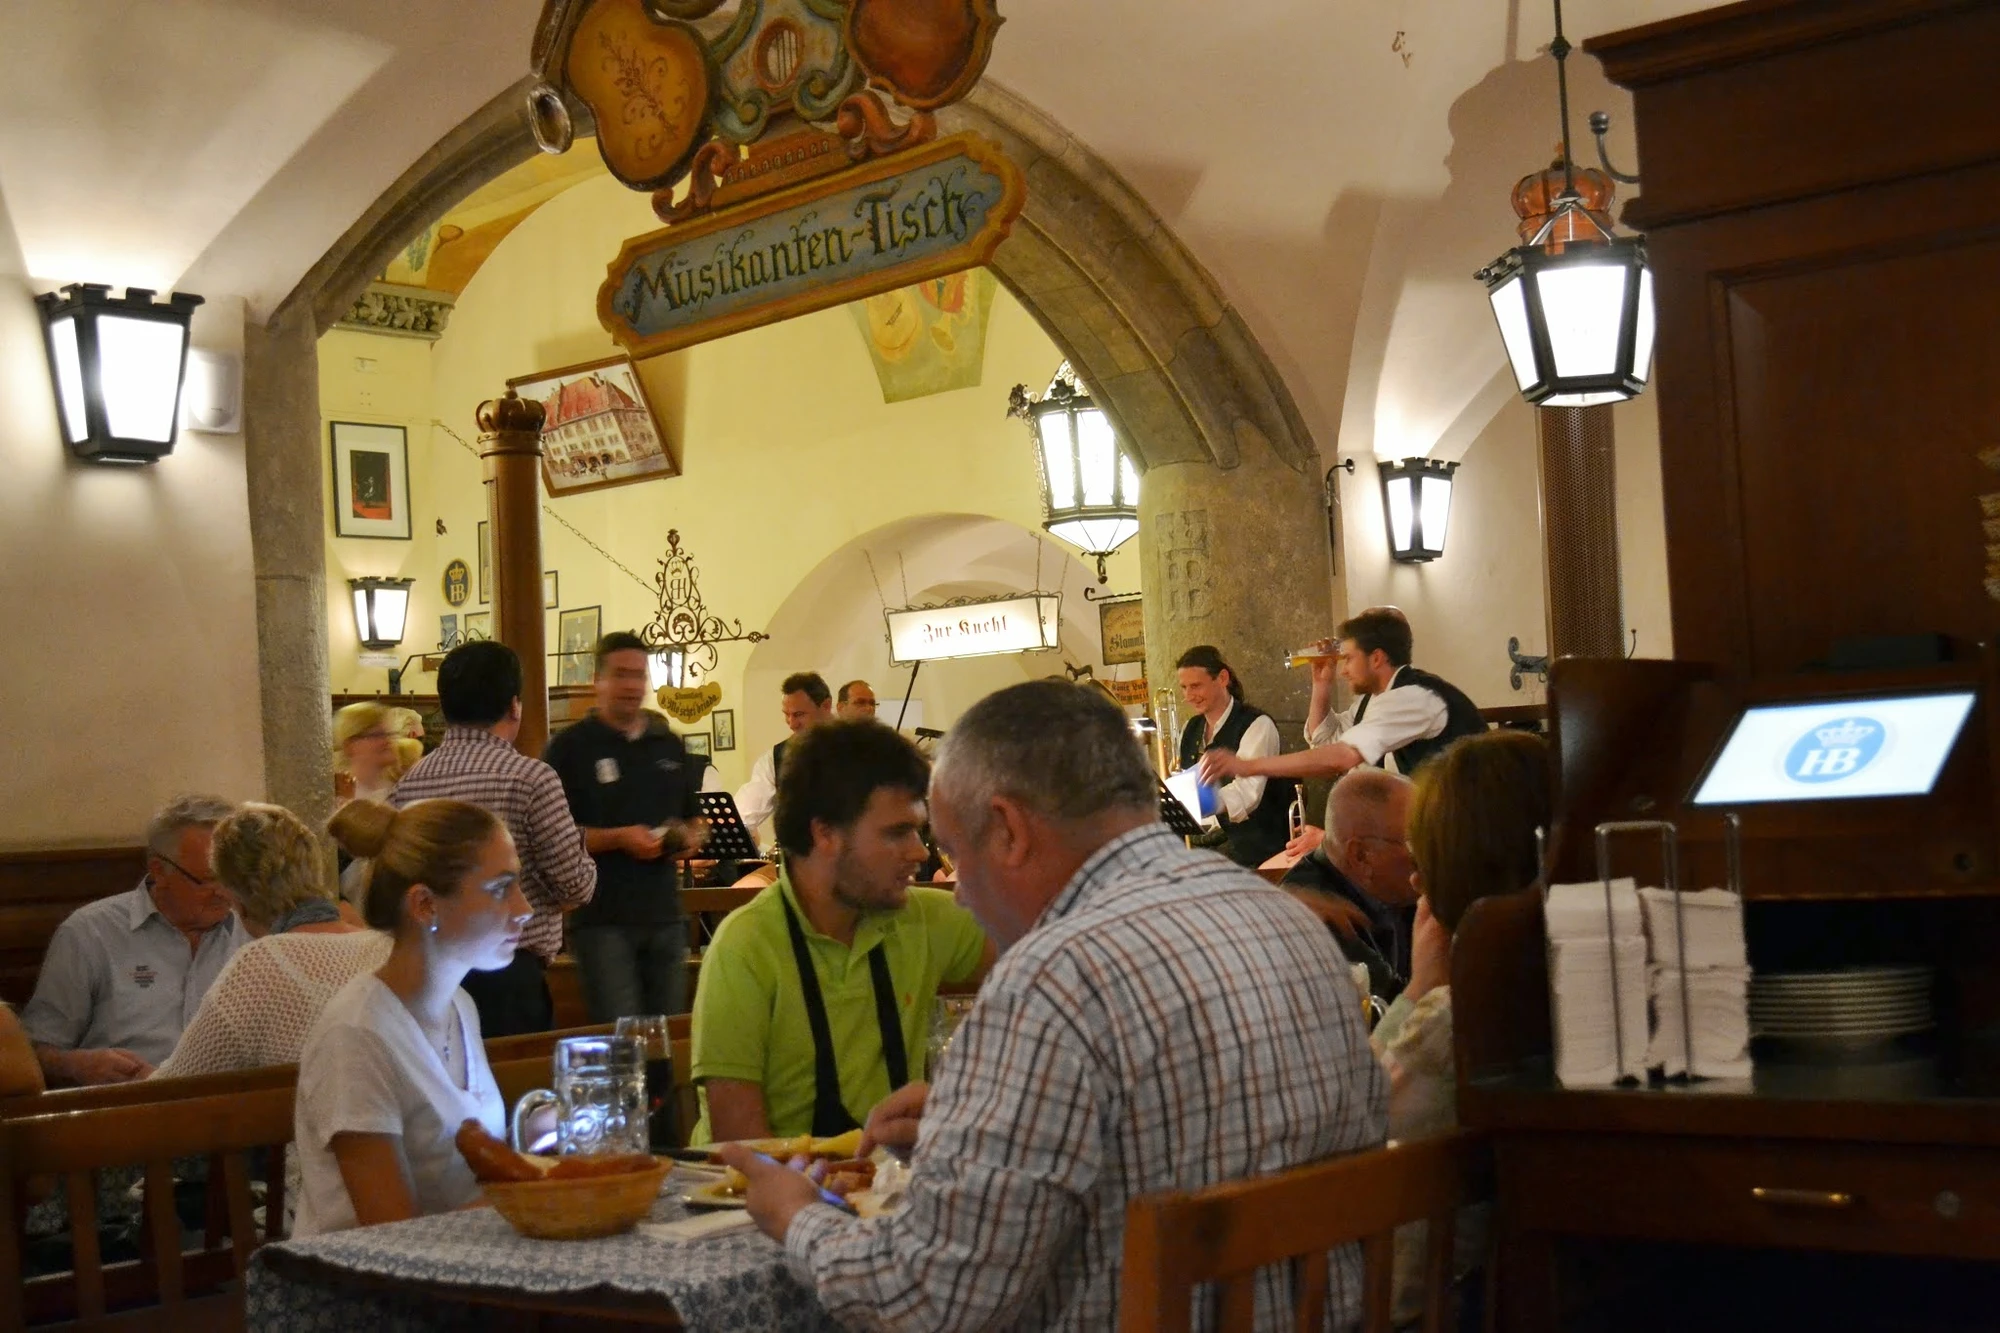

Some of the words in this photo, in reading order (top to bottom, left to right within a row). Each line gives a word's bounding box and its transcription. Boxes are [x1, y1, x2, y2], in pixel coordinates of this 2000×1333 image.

[450, 583, 465, 602] HB
[923, 624, 952, 643] Zur
[1796, 748, 1860, 776] HB
